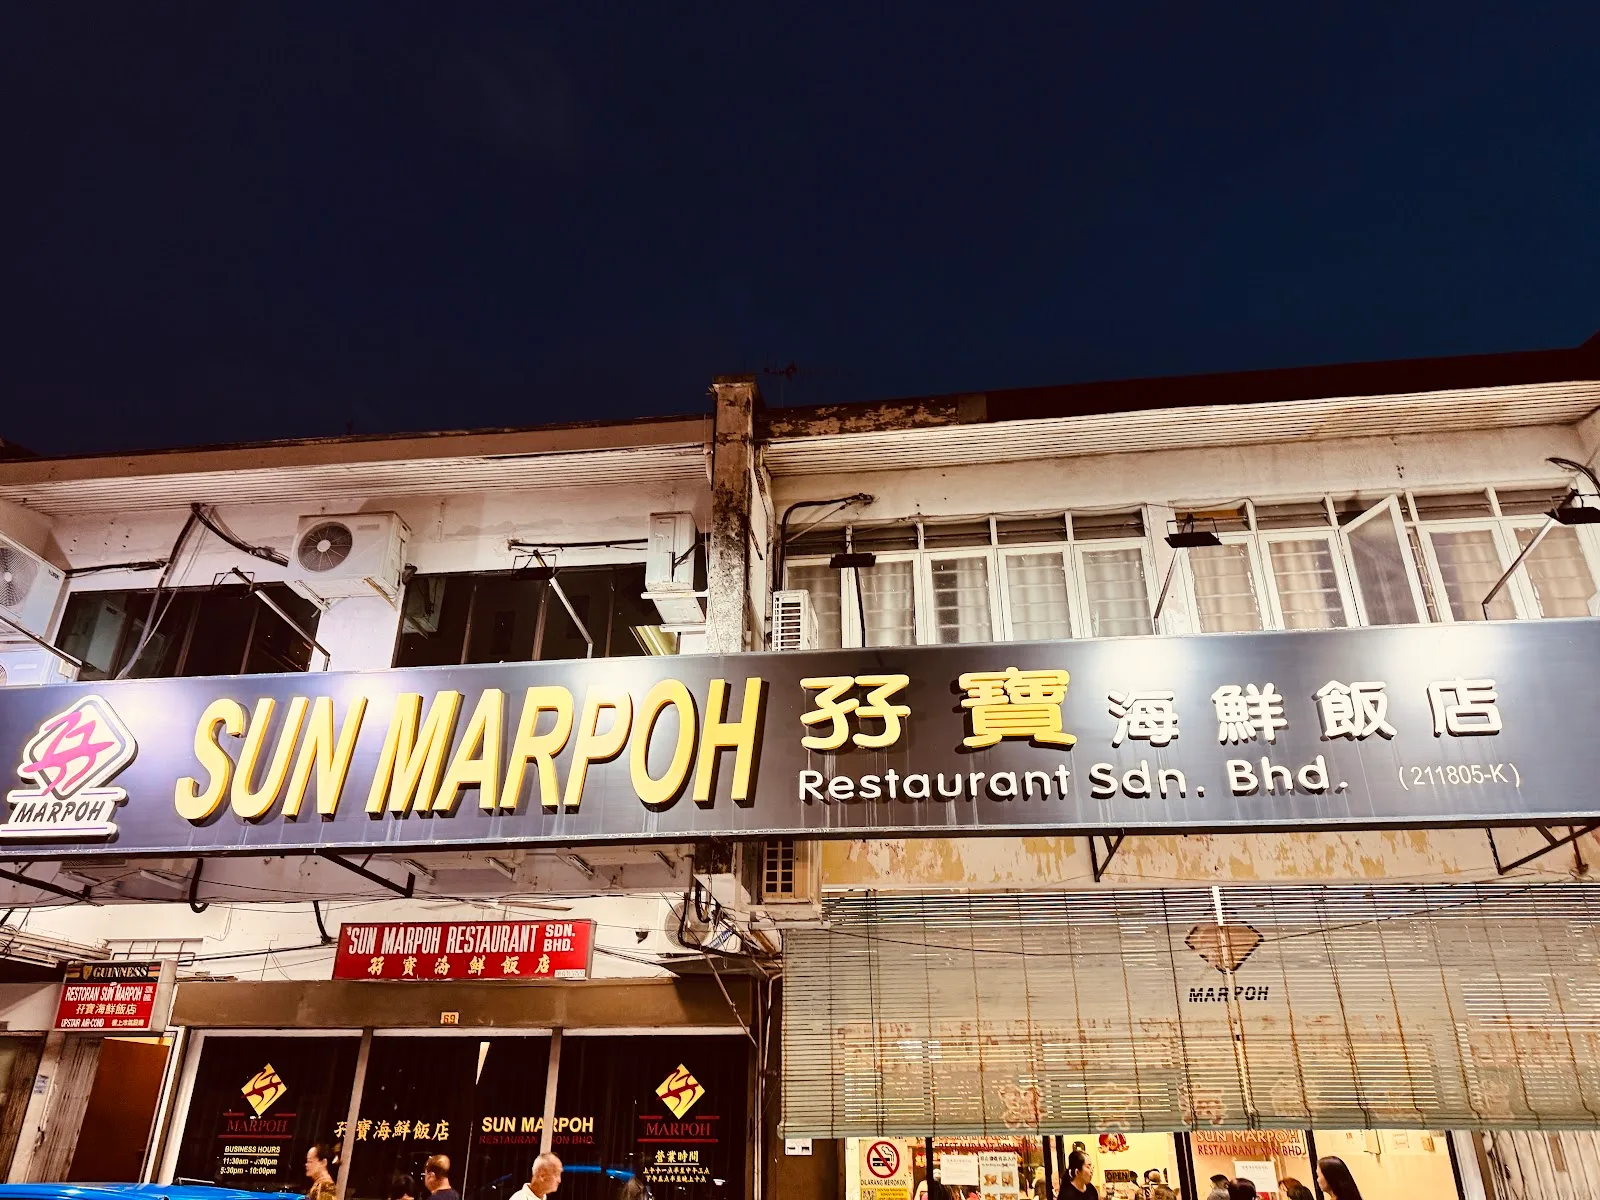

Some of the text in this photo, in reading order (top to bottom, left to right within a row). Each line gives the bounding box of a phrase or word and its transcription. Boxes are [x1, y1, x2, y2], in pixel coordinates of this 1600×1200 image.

[175, 677, 768, 822] SUN MARPOH
[799, 755, 1521, 802] Restaurant Sdn. Bhd. (211805-K)
[14, 799, 105, 824] MARPOH
[348, 923, 576, 955] SUN MARPOH RESTAURANT SDN.
[543, 938, 575, 952] BHD.
[93, 966, 148, 978] GUINNESS
[65, 986, 100, 1001] RESTORAN
[100, 986, 116, 1001] SUN
[114, 985, 143, 1001] MARPOH
[61, 1018, 105, 1027] UPSTAIR AIR-COND
[443, 1014, 456, 1024] 69
[226, 1120, 288, 1133] MARPOH
[481, 1116, 516, 1133] SUN
[645, 1122, 711, 1136] MARPOH
[1196, 1129, 1302, 1143] SUN MARPOH
[1197, 1144, 1257, 1156] RESTAURANT
[1106, 1171, 1128, 1181] OPEN
